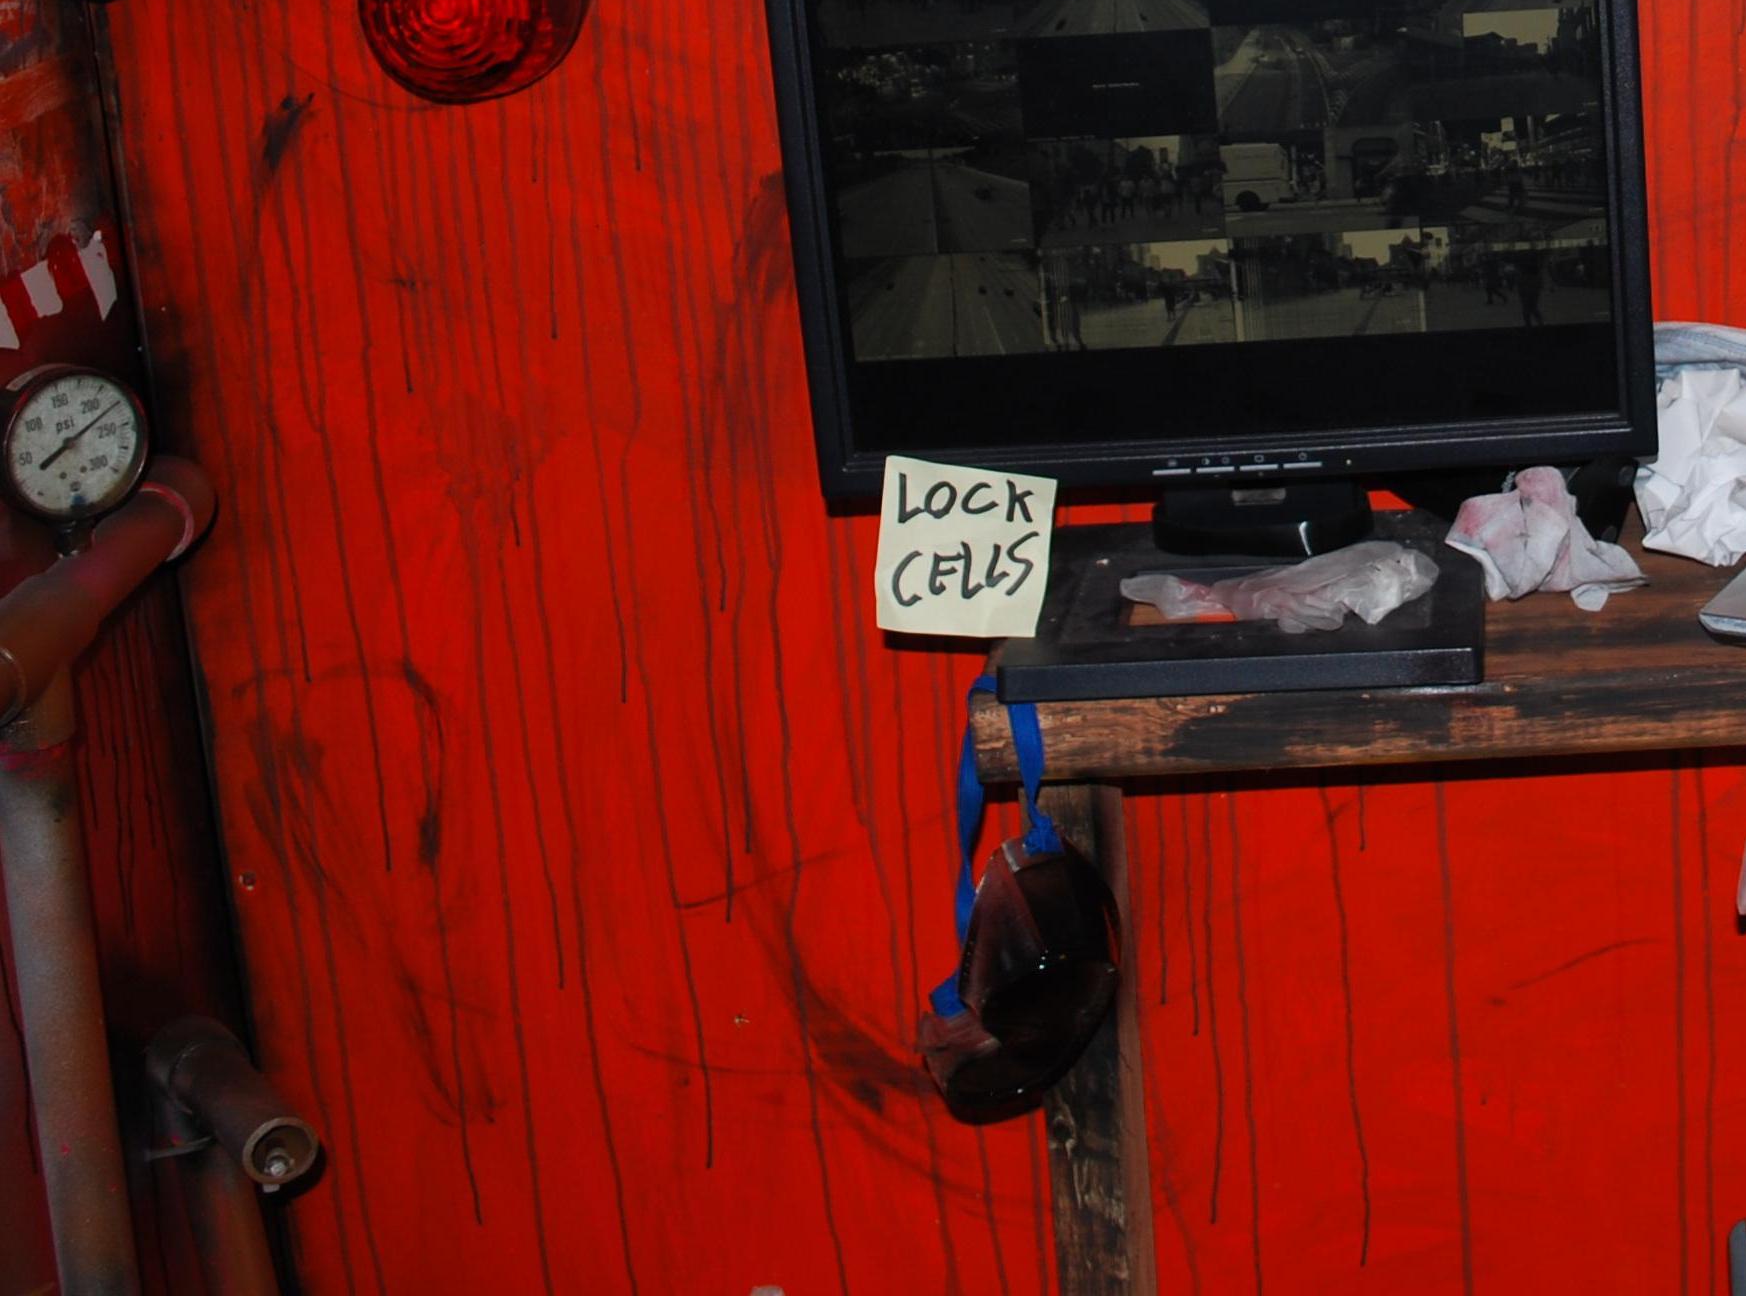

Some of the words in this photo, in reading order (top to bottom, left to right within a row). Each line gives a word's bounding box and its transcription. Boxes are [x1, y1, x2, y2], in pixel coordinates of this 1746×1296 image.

[51, 392, 69, 409] 150
[81, 397, 100, 414] 200
[55, 415, 75, 435] psi
[97, 422, 117, 439] 250
[19, 450, 33, 466] 50
[897, 472, 1035, 524] LOCK
[892, 531, 1041, 607] CELLS
